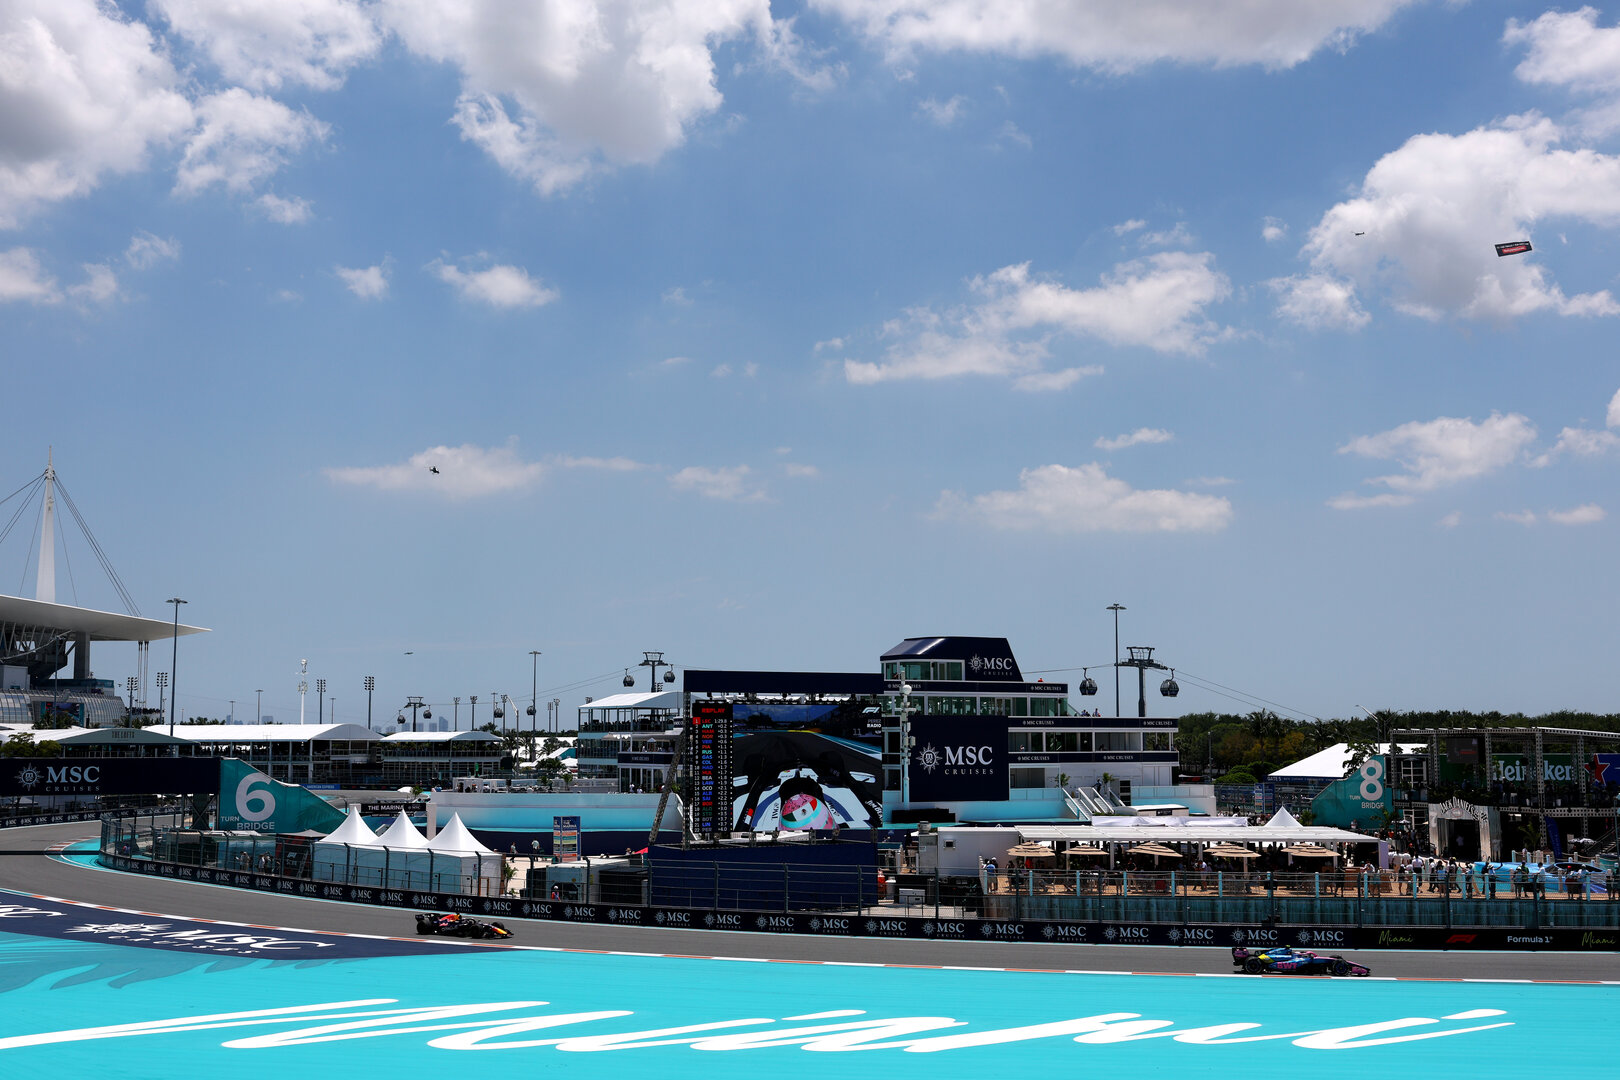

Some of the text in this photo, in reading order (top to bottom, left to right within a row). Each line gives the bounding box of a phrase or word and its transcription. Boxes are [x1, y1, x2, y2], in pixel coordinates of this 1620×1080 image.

[983, 658, 1012, 669] MSC
[945, 746, 992, 765] MSC
[46, 766, 99, 783] MSC
[1360, 759, 1383, 801] 8
[236, 772, 276, 821] 6
[1440, 799, 1453, 814] JACK
[183, 868, 192, 876] MSC
[260, 878, 271, 887] MSC
[282, 881, 293, 889] MSC
[305, 883, 316, 892] MSC
[330, 886, 342, 895] MSC
[358, 889, 372, 898] MSC
[388, 892, 403, 901] MSC
[421, 895, 437, 904] MSC
[455, 898, 472, 908] MSC
[493, 901, 511, 910] MSC
[532, 904, 552, 913] MSC
[575, 907, 595, 917] MSC
[619, 910, 641, 919] MSC
[667, 912, 690, 922] MSC
[717, 914, 741, 924] MSC
[769, 917, 794, 926] MSC
[823, 919, 849, 928] MSC
[880, 921, 906, 930] MSC
[937, 923, 964, 933] MSC
[996, 924, 1024, 934] MSC
[1058, 926, 1086, 936] MSC
[1120, 928, 1149, 937] MSC
[1184, 929, 1213, 939] MSC
[1248, 930, 1278, 940] MSC
[1313, 931, 1344, 941] MSC
[1379, 929, 1414, 946] Miami
[141, 930, 335, 949] MSC
[1582, 931, 1616, 948] Miami
